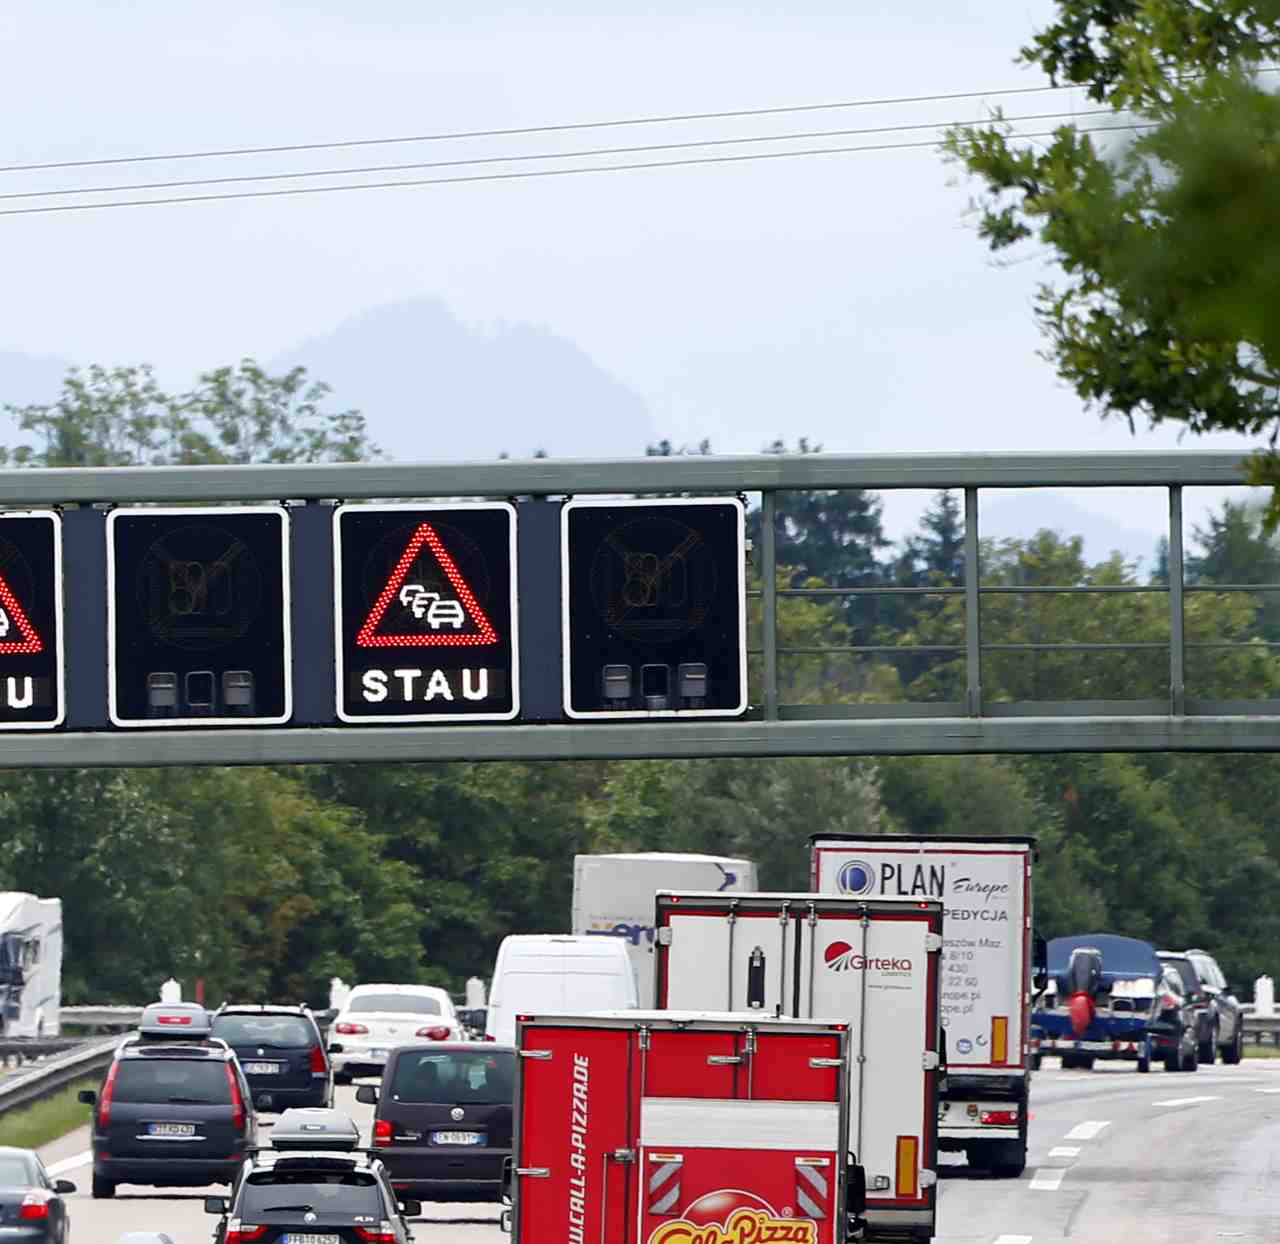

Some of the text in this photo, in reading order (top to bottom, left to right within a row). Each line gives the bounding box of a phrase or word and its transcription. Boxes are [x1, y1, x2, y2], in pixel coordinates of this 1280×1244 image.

[362, 668, 488, 702] STAU
[880, 863, 1008, 902] PLAN Europe
[850, 955, 912, 970] Girteka
